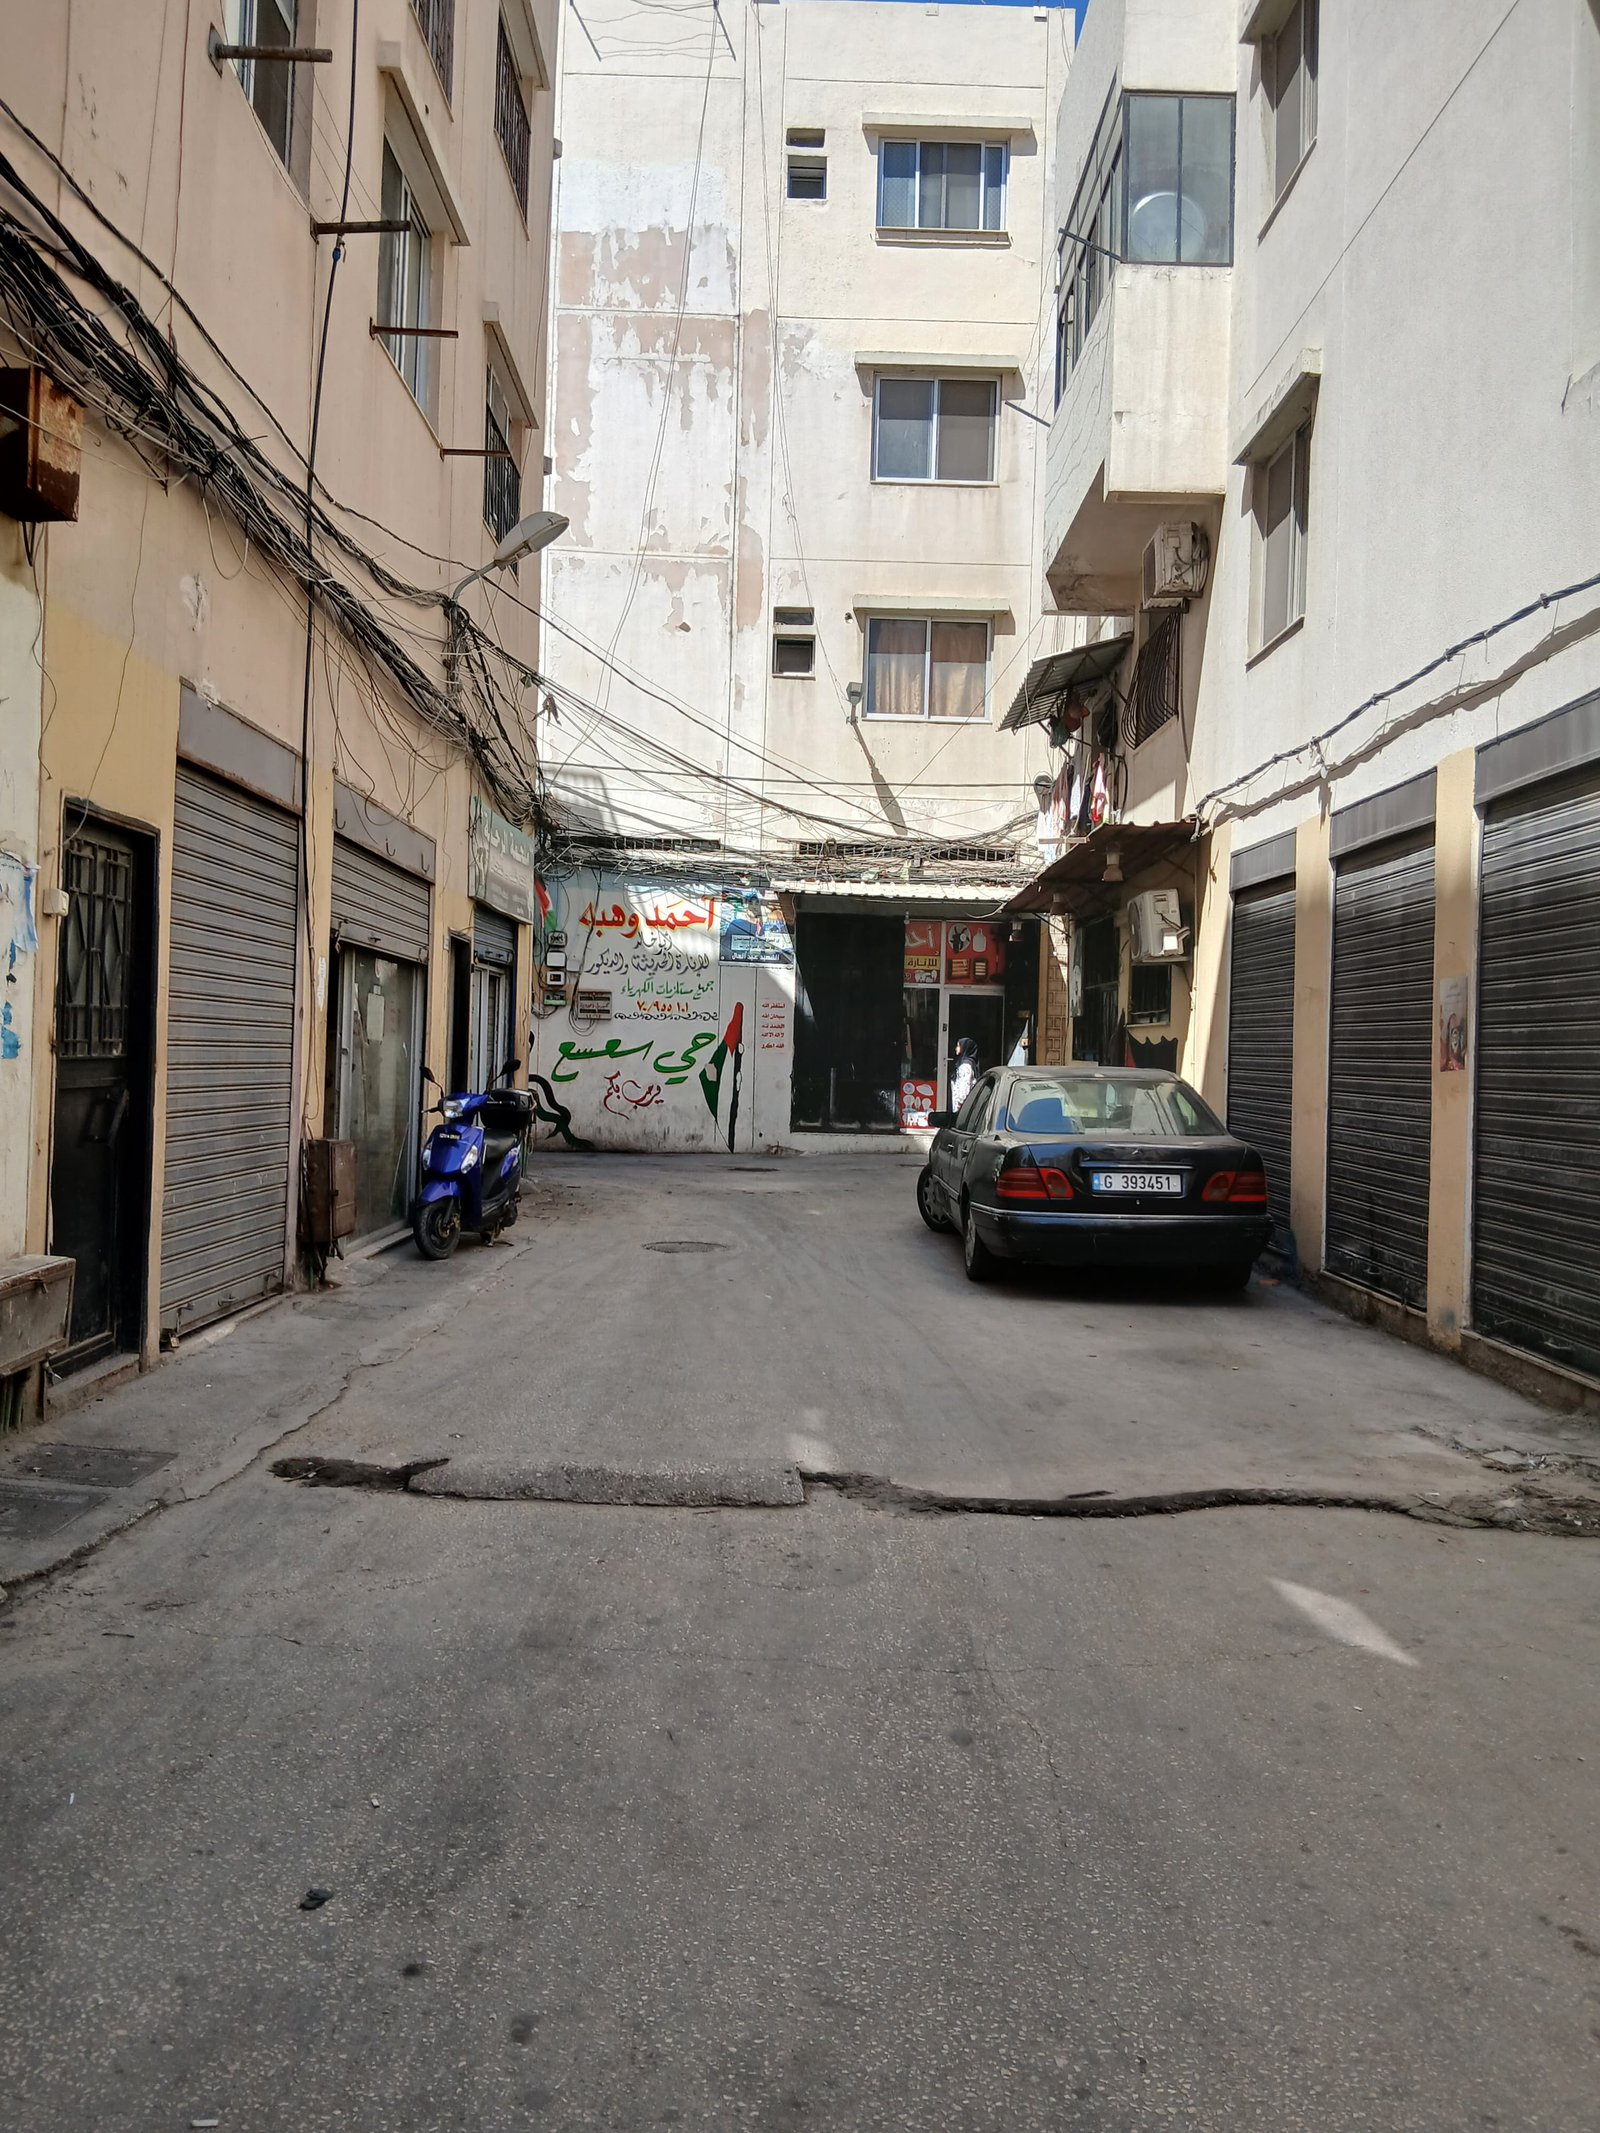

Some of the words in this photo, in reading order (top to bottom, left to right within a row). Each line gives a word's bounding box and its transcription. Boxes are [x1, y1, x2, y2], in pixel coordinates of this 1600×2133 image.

[645, 894, 716, 931] أحمد
[633, 931, 657, 949] خالد
[584, 948, 630, 975] والديكور
[631, 949, 675, 977] الحديثة
[621, 978, 654, 998] الكهرباء
[656, 982, 693, 999] مستلزمات
[693, 980, 715, 1000] جميع
[653, 1032, 717, 1085] حي
[603, 1070, 630, 1120] بكم
[1104, 1174, 1113, 1189] G
[1121, 1175, 1171, 1191] 393451
